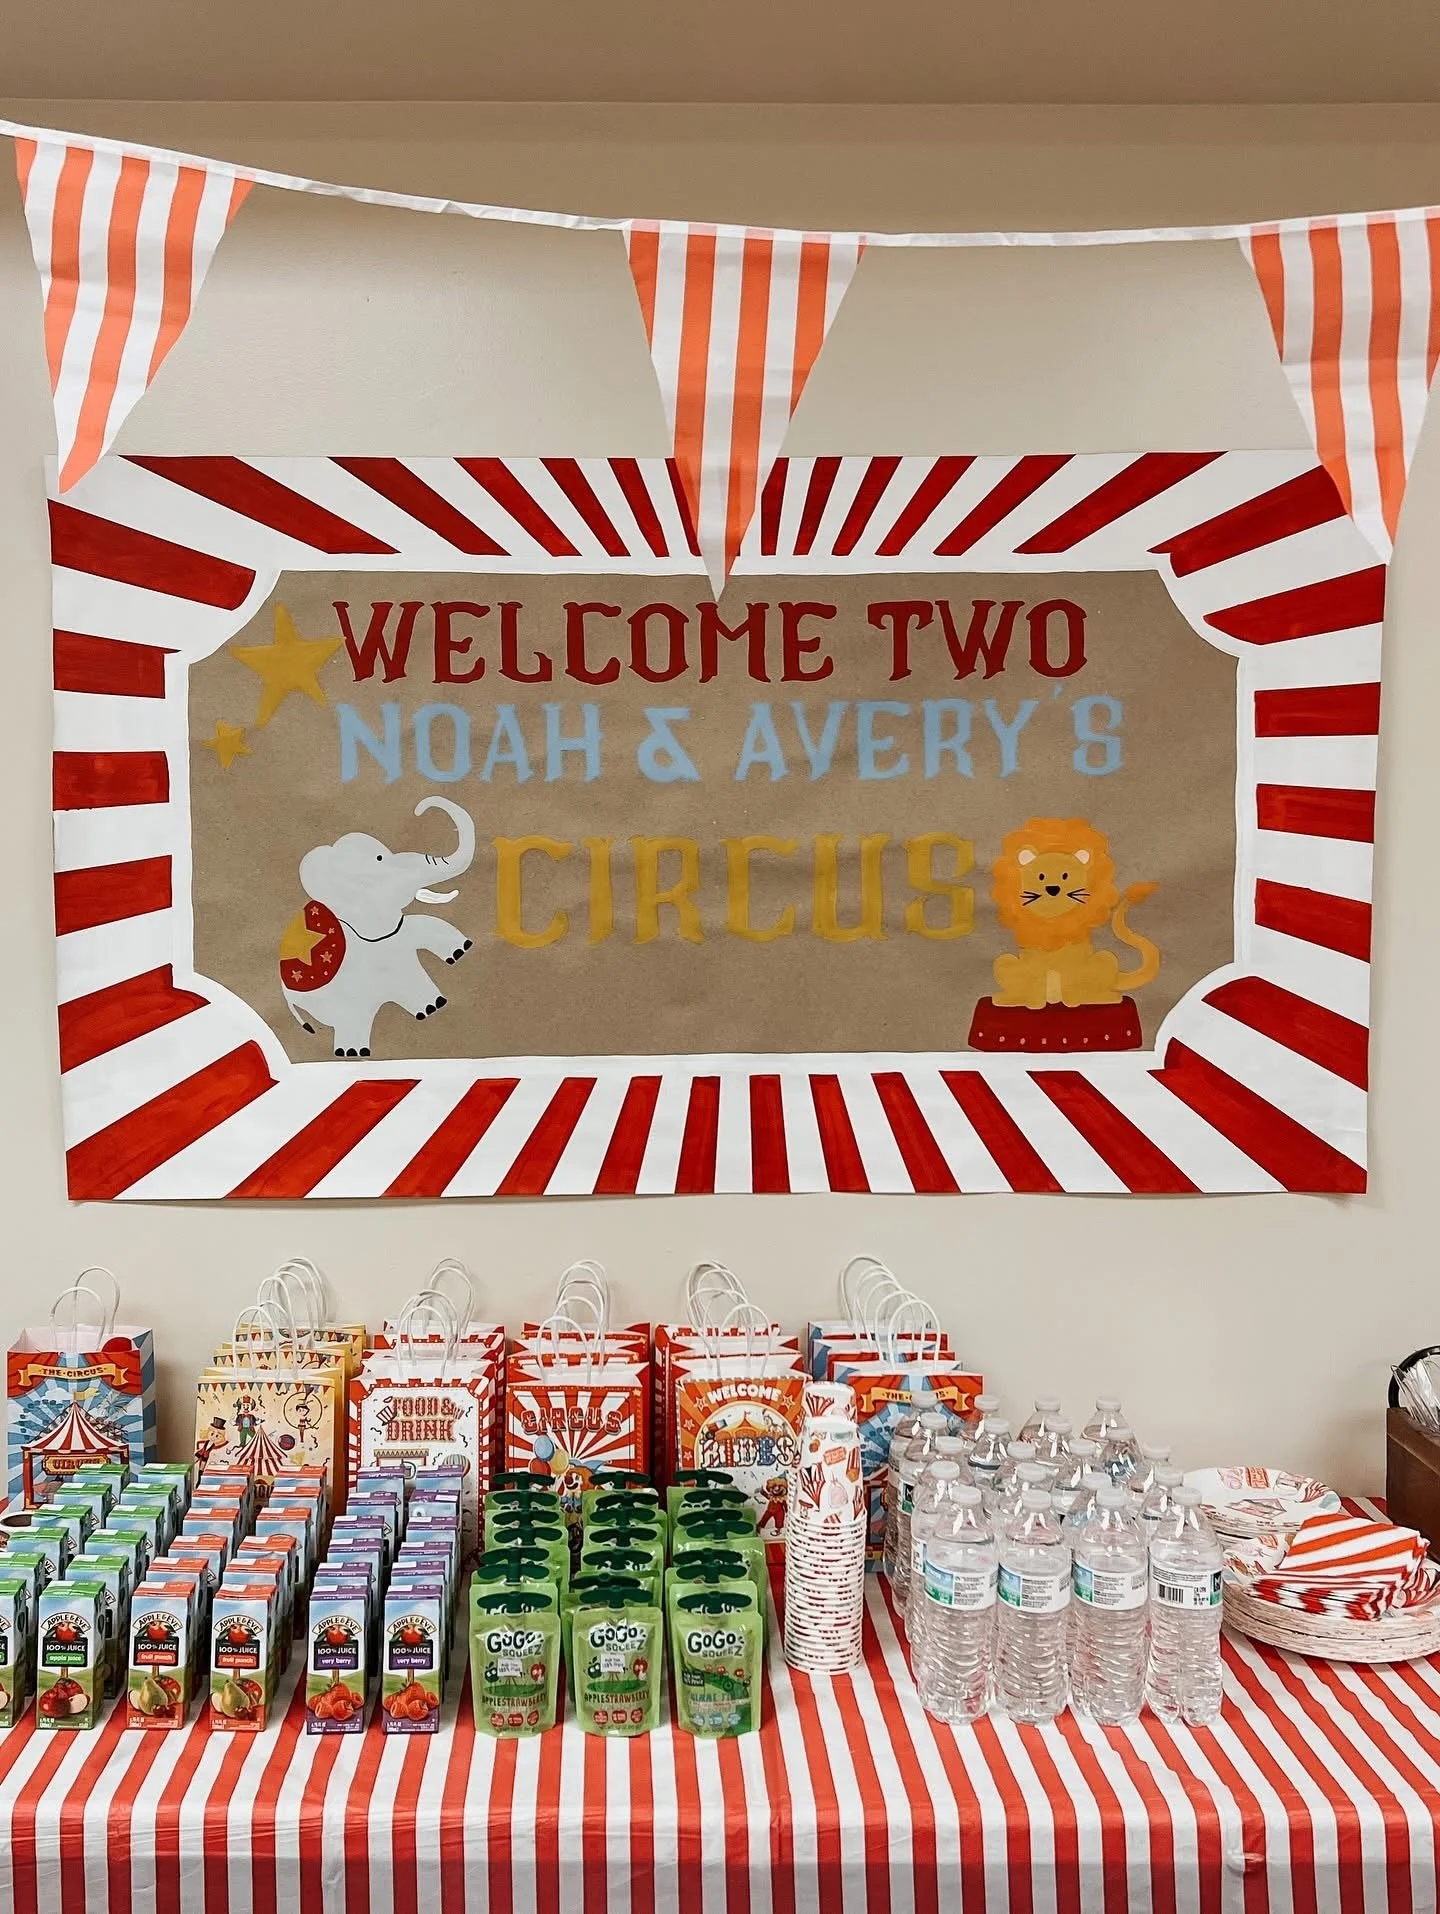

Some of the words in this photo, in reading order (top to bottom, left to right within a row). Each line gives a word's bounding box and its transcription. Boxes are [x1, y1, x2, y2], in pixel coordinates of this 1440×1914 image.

[333, 600, 838, 686] WELCOME
[866, 597, 1088, 681] TWO
[335, 702, 602, 784] NOAH
[638, 706, 700, 783] &
[735, 683, 1123, 781] AVERY'S
[491, 831, 978, 950] CIRCUS
[42, 1367, 63, 1376] THE
[66, 1367, 104, 1378] CIRCUS
[707, 1383, 782, 1404] WELCOME
[885, 1391, 904, 1400] THE
[390, 1397, 438, 1416] FOOD
[521, 1406, 623, 1435] CIRCUS
[386, 1419, 456, 1442] DRINK
[700, 1435, 795, 1468] RIDES
[47, 1613, 69, 1629] APPLE
[139, 1613, 161, 1629] APPLE
[219, 1616, 242, 1633] APPLE
[318, 1617, 340, 1633] APPLE
[393, 1617, 415, 1633] APPLE
[67, 1644, 86, 1652] JUICE
[687, 1630, 736, 1653] GoGo
[238, 1646, 258, 1654] JUICE
[338, 1647, 357, 1655] JUICE
[412, 1647, 431, 1655] JUICE
